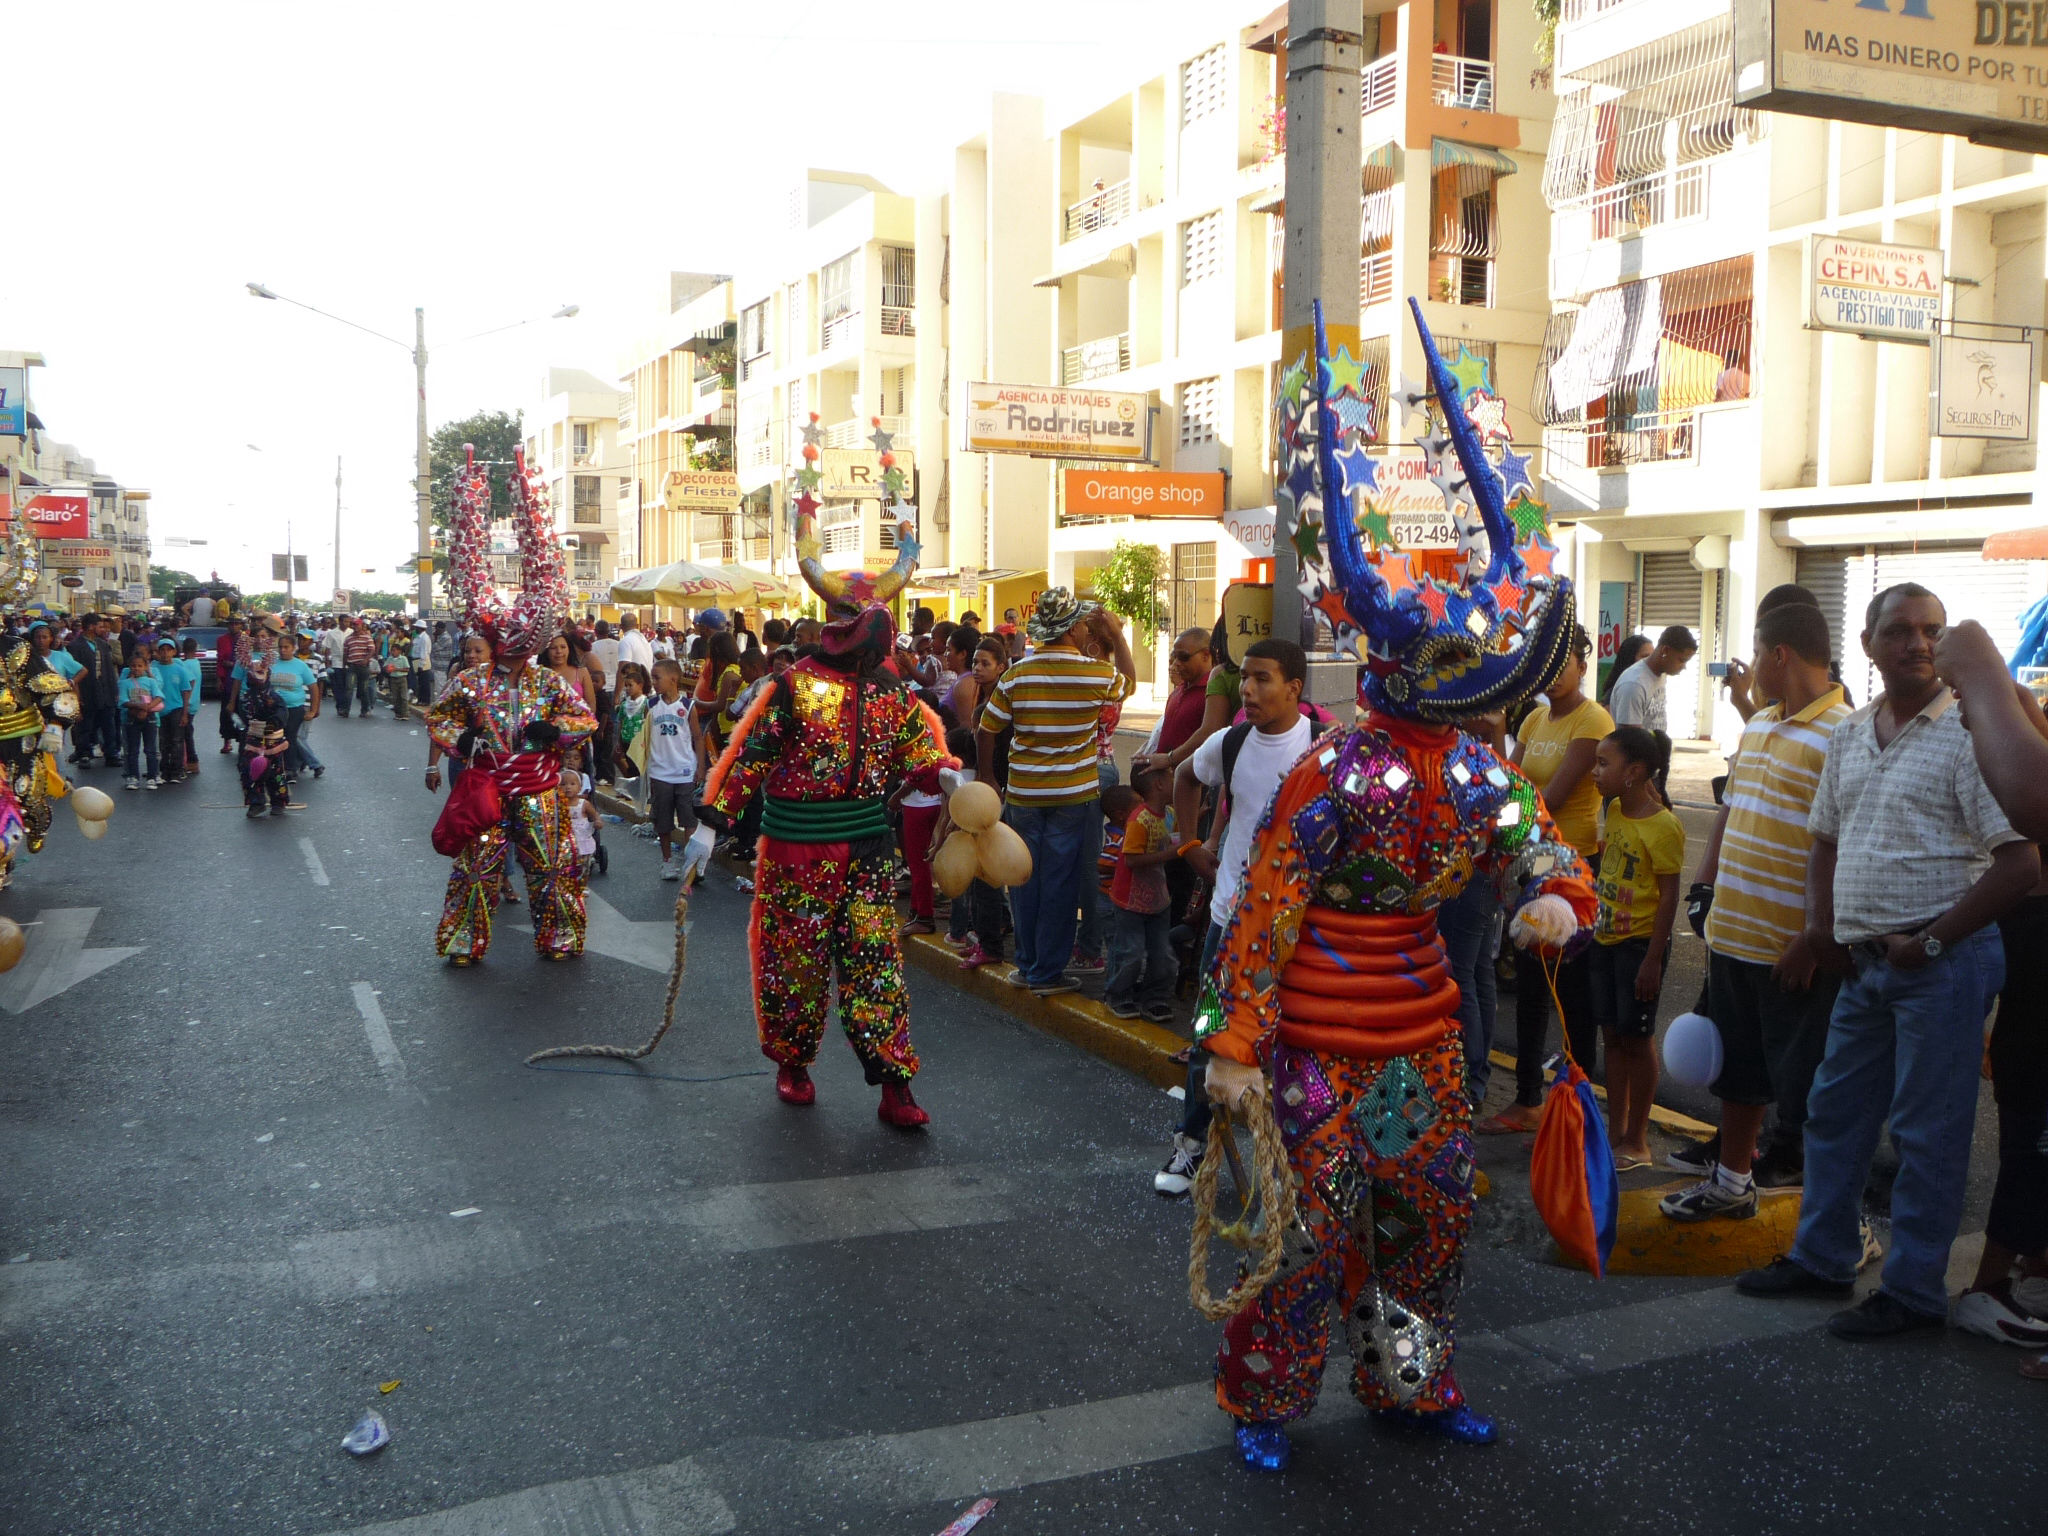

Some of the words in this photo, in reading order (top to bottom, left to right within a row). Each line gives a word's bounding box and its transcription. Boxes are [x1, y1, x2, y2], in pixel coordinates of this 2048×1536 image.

[1804, 29, 1859, 57] MAS
[1868, 40, 1960, 73] DINERO
[1967, 56, 2015, 82] POR
[2016, 95, 2048, 121] TE
[1835, 243, 1925, 265] INVERCIONES
[1822, 257, 1890, 288] CEPIN,
[1894, 267, 1937, 290] S.A.
[1820, 286, 1881, 303] AGENCIA
[1890, 295, 1938, 310] VIAJES
[1837, 301, 1895, 326] PRESTIGIO
[997, 390, 1048, 404] AGENCIA
[1052, 392, 1067, 405] DE
[1070, 395, 1111, 408] VIAJES
[1007, 404, 1135, 437] Rodriguez
[1946, 407, 1991, 425] SEGUROS
[671, 472, 736, 486] Decoresa
[684, 486, 737, 497] Fiesta
[1086, 480, 1154, 505] Orange
[1160, 483, 1205, 506] shop
[28, 508, 73, 522] Claro
[1428, 514, 1446, 525] ORO
[62, 548, 111, 557] CIFINOR
[570, 579, 602, 587] Centro
[680, 577, 737, 596] BON
